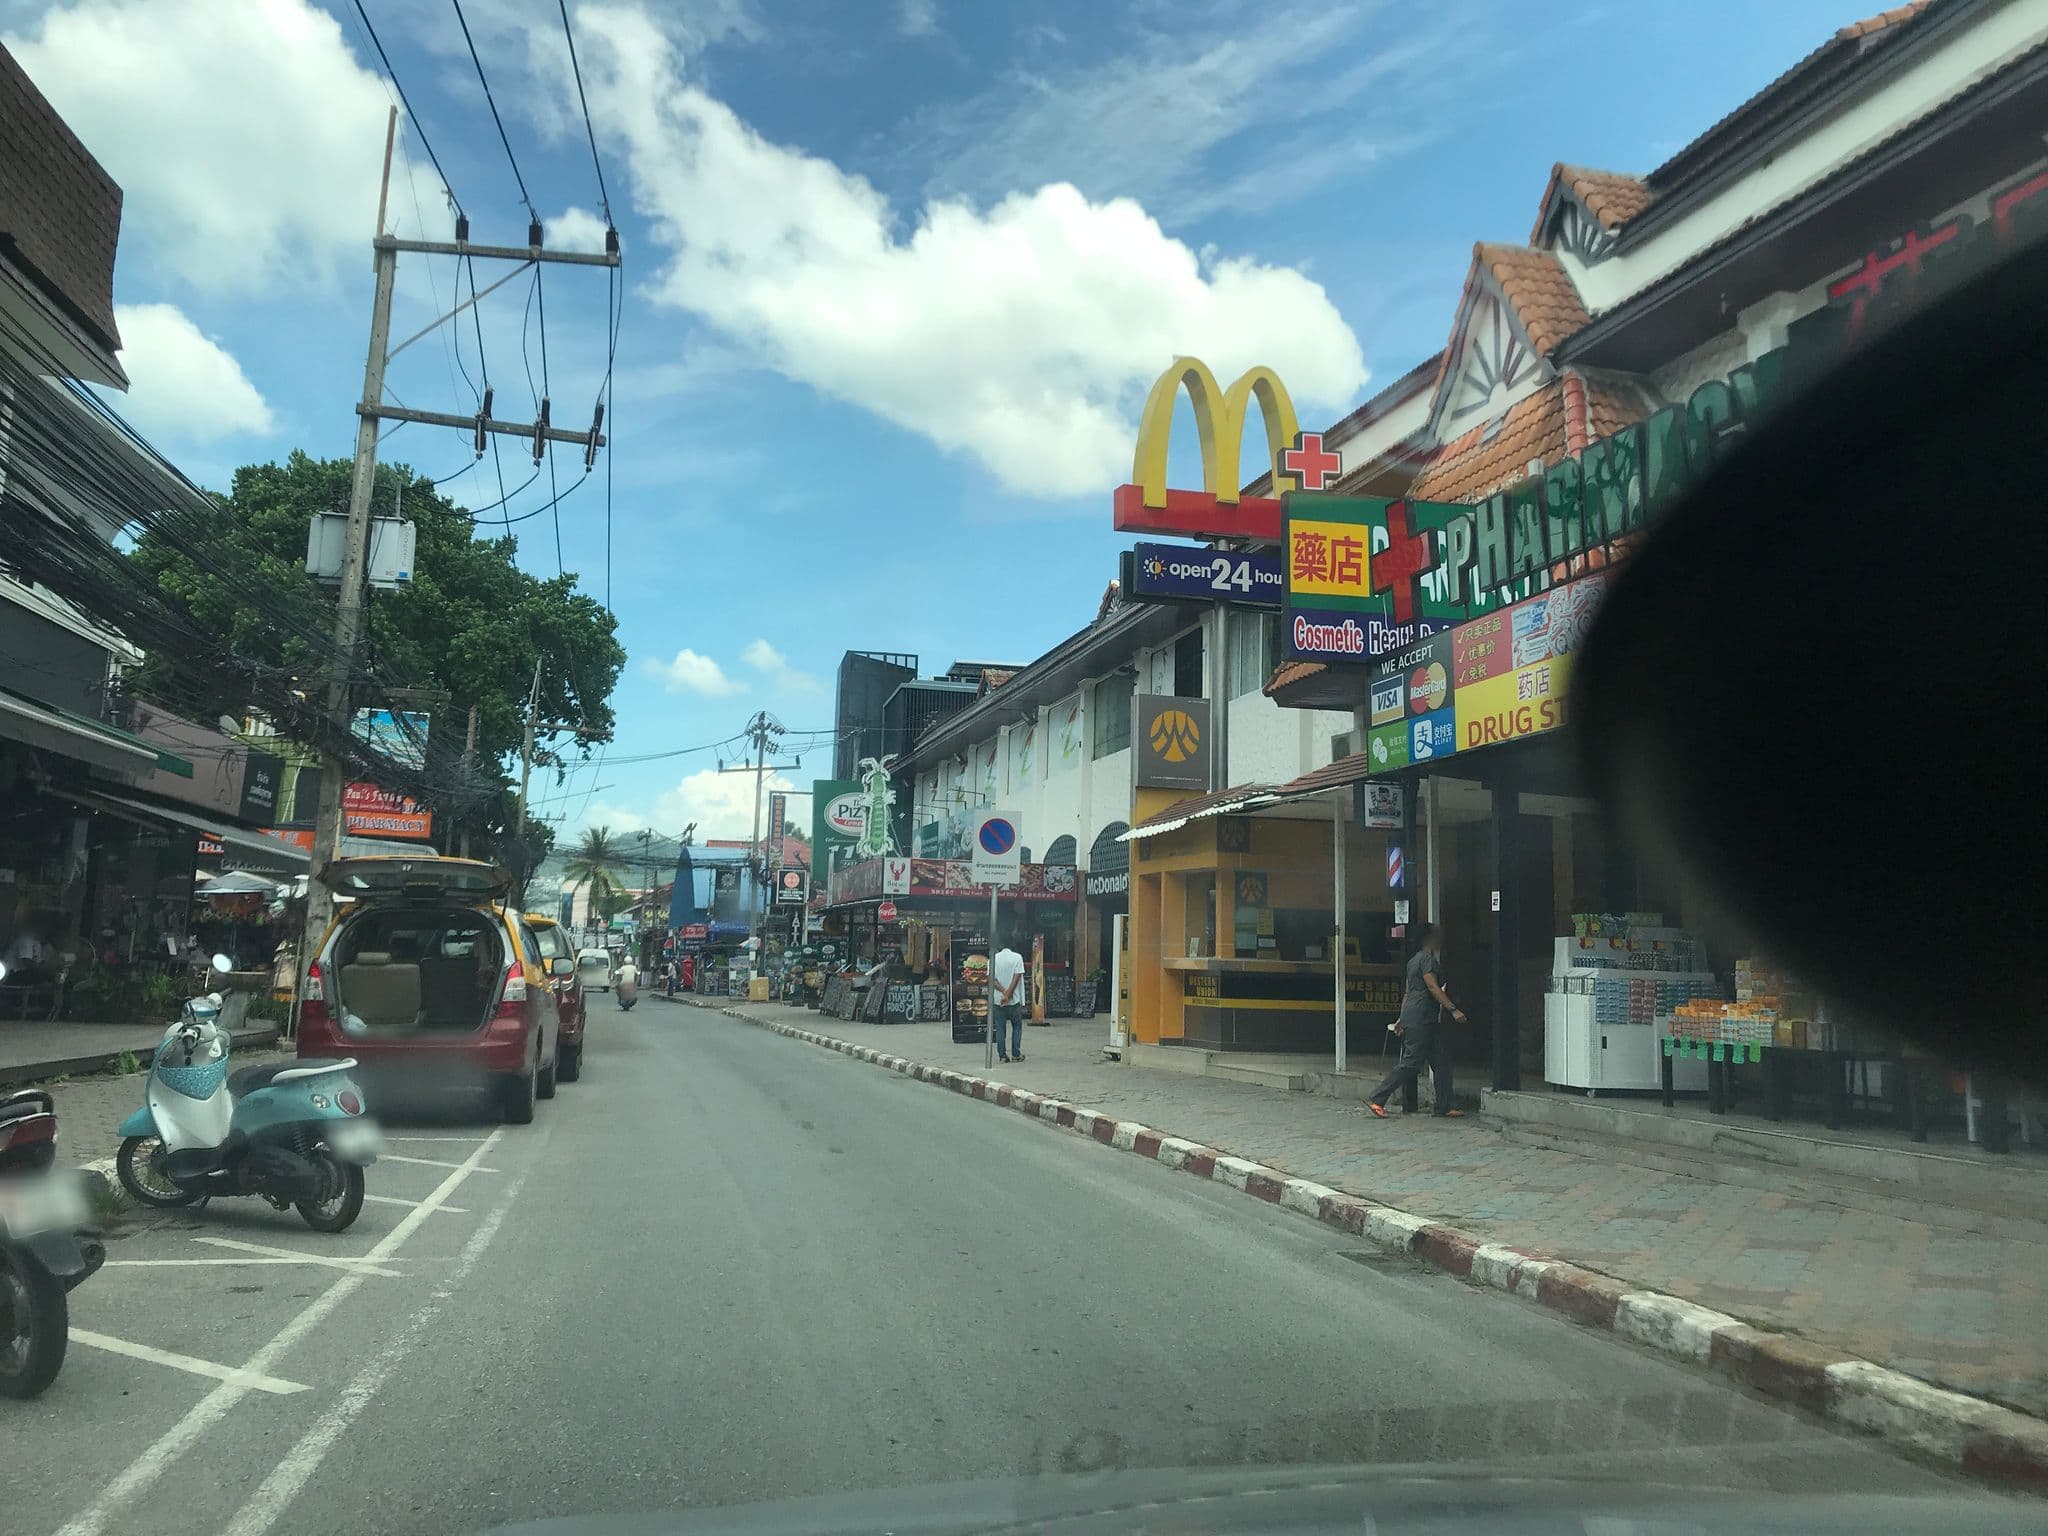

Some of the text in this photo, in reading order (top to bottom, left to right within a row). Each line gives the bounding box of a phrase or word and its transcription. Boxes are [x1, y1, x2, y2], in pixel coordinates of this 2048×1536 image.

[1292, 531, 1364, 586] 藥店
[1169, 558, 1282, 593] open 24 hou
[1293, 616, 1364, 655] Cosmetic
[1380, 644, 1434, 676] WE ACCEPT
[1410, 675, 1447, 700] MasterCard
[1517, 667, 1550, 701] 药店
[1376, 689, 1398, 712] VISA
[1467, 697, 1569, 747] DRUG ST
[346, 815, 426, 832] PHARMACY
[1196, 986, 1217, 997] UNION
[1344, 981, 1400, 992] WESER
[1364, 991, 1400, 1002] UNIO
